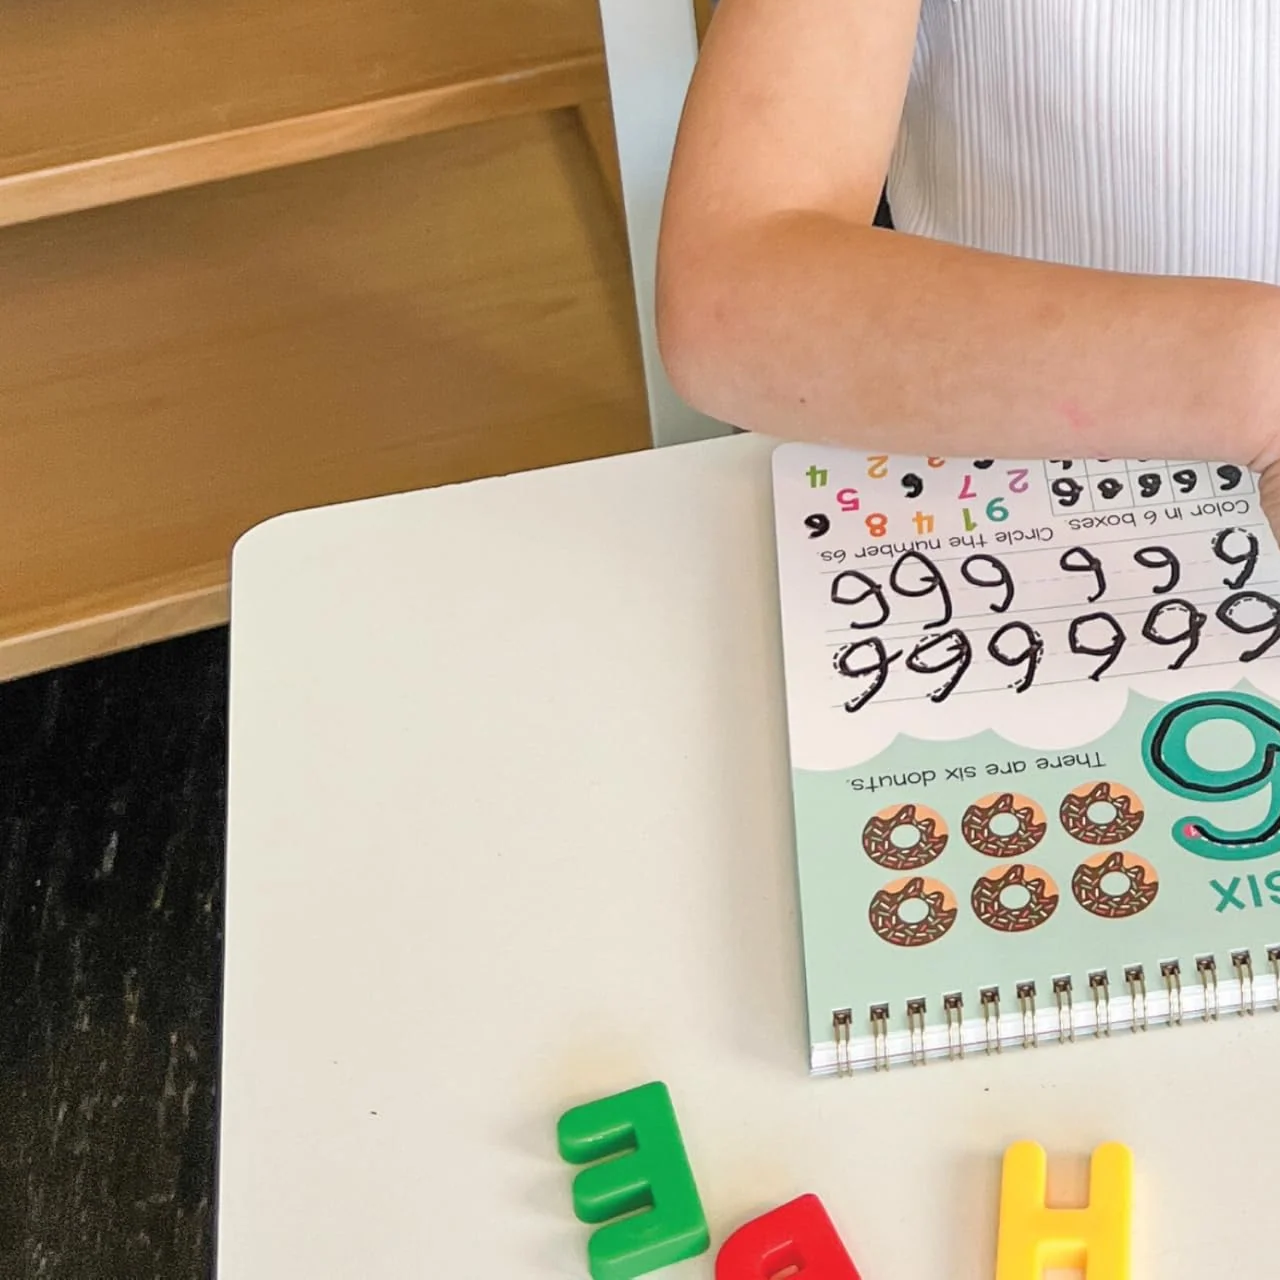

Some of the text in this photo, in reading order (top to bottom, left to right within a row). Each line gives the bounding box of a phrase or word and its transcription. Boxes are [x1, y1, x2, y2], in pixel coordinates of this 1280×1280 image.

[806, 465, 828, 488] 4
[867, 455, 888, 479] 2
[958, 475, 977, 499] 7
[1007, 468, 1029, 493] 2
[837, 488, 859, 512] 5
[865, 513, 888, 537] 8
[912, 512, 934, 534] 4
[962, 508, 977, 531] 1
[1065, 500, 1249, 530] Color in 6 boxes.
[949, 534, 987, 547] the
[995, 527, 1054, 542] Circle
[855, 539, 941, 557] number
[847, 751, 1105, 793] There are six donuts.
